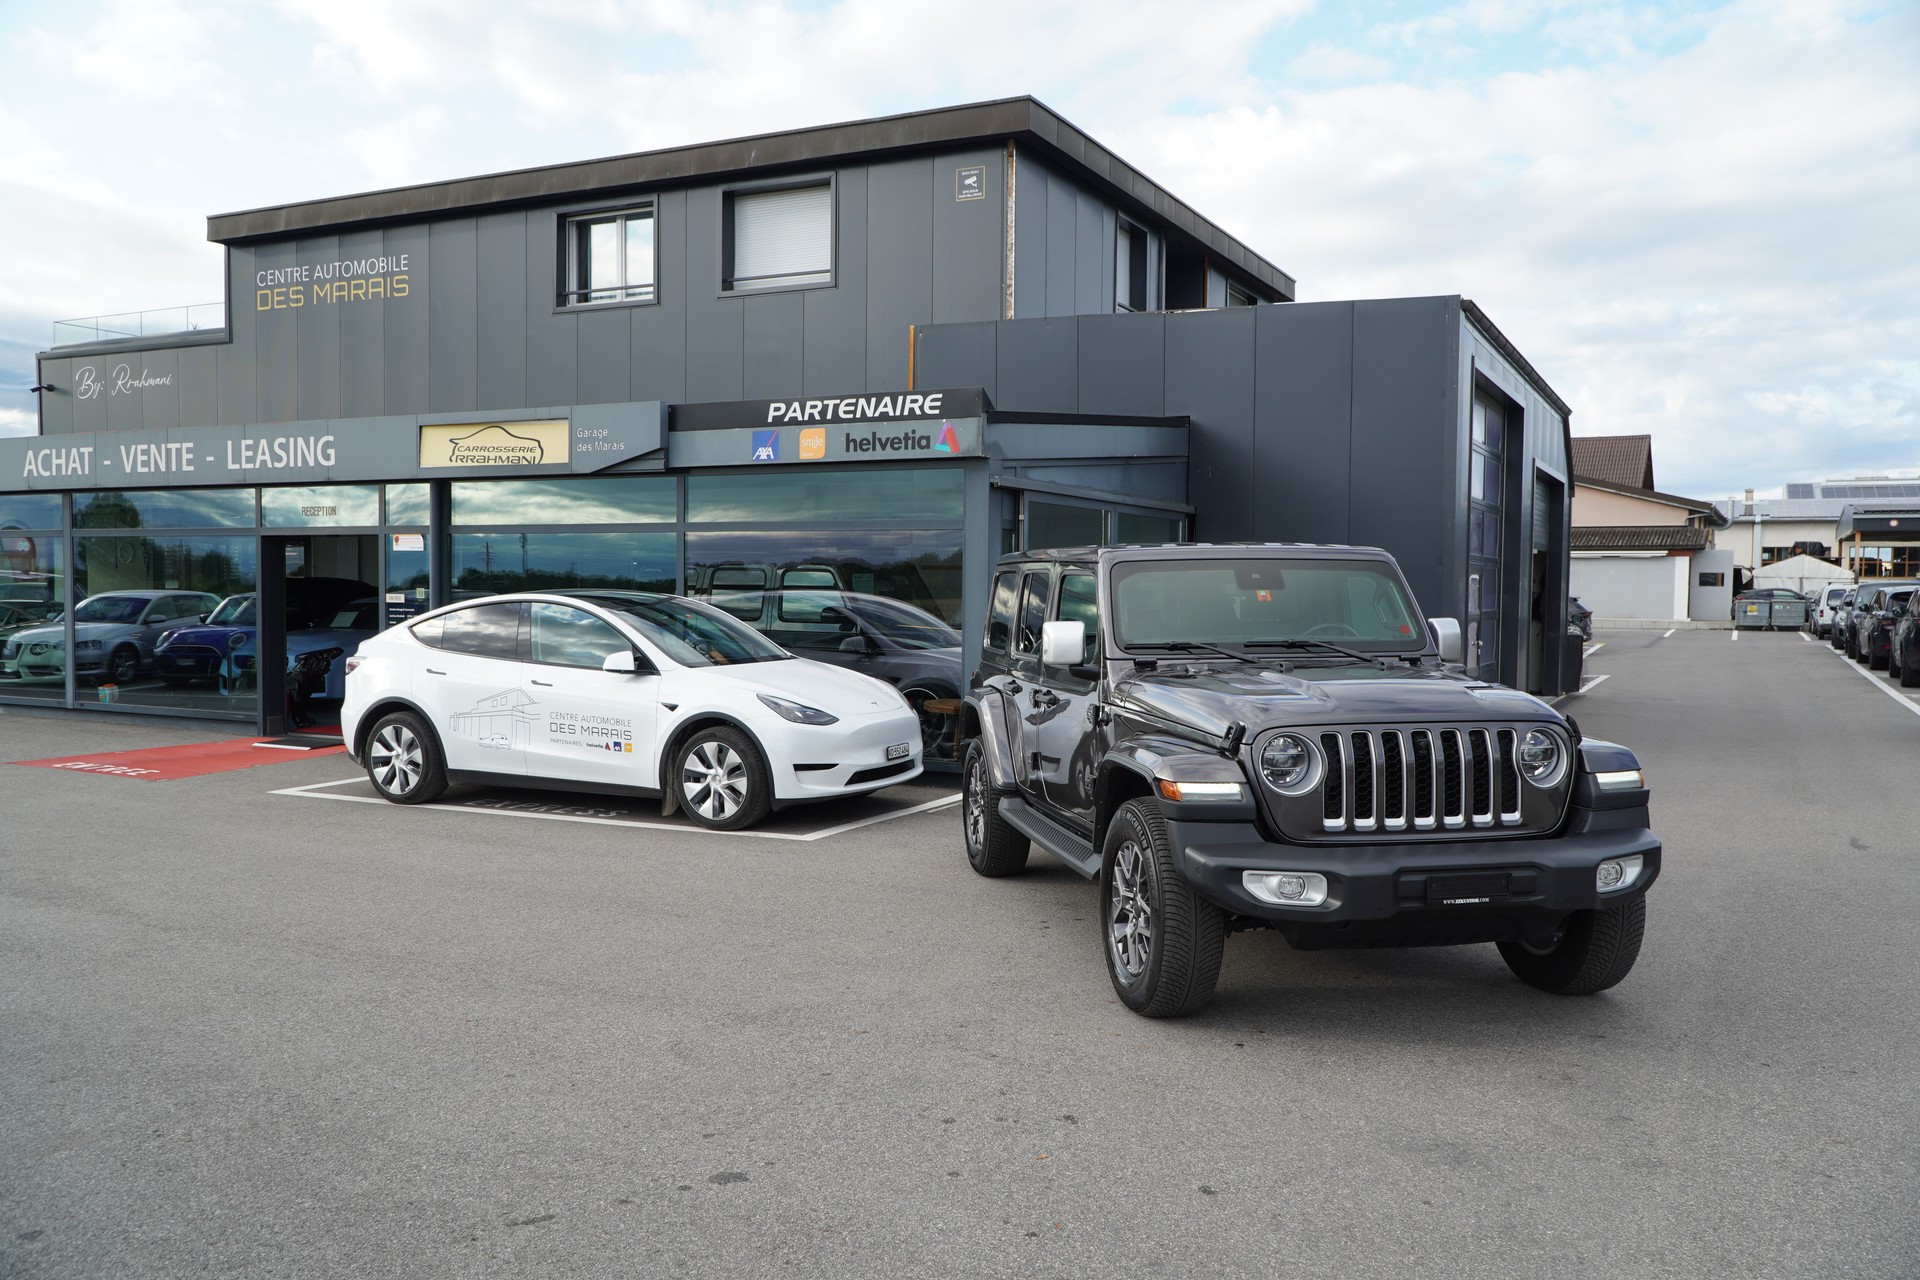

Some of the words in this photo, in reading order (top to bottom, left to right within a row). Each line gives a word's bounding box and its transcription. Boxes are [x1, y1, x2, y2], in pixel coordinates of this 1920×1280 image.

[257, 266, 310, 287] CENTRE
[313, 254, 409, 280] AUTOMOBILE
[257, 286, 304, 311] DES
[313, 275, 409, 305] MARAIS
[75, 366, 105, 400] By:
[111, 363, 173, 396] Rrahmani
[767, 393, 943, 423] PARTENAIRE
[576, 427, 608, 439] Garage
[845, 429, 931, 453] helvetia
[456, 445, 537, 453] CARROSSERIE
[576, 442, 593, 452] des
[594, 440, 625, 451] Marais
[801, 436, 824, 449] smile
[23, 446, 93, 478] ACHAT
[120, 441, 195, 473] VENTE
[226, 435, 336, 470] LEASING
[752, 446, 774, 460] AXA
[301, 505, 337, 517] RECEPTION
[549, 711, 578, 722] CENTRE
[580, 715, 632, 728] AUTOMOBILE
[549, 722, 576, 734] DES
[580, 725, 632, 741] MARAIS
